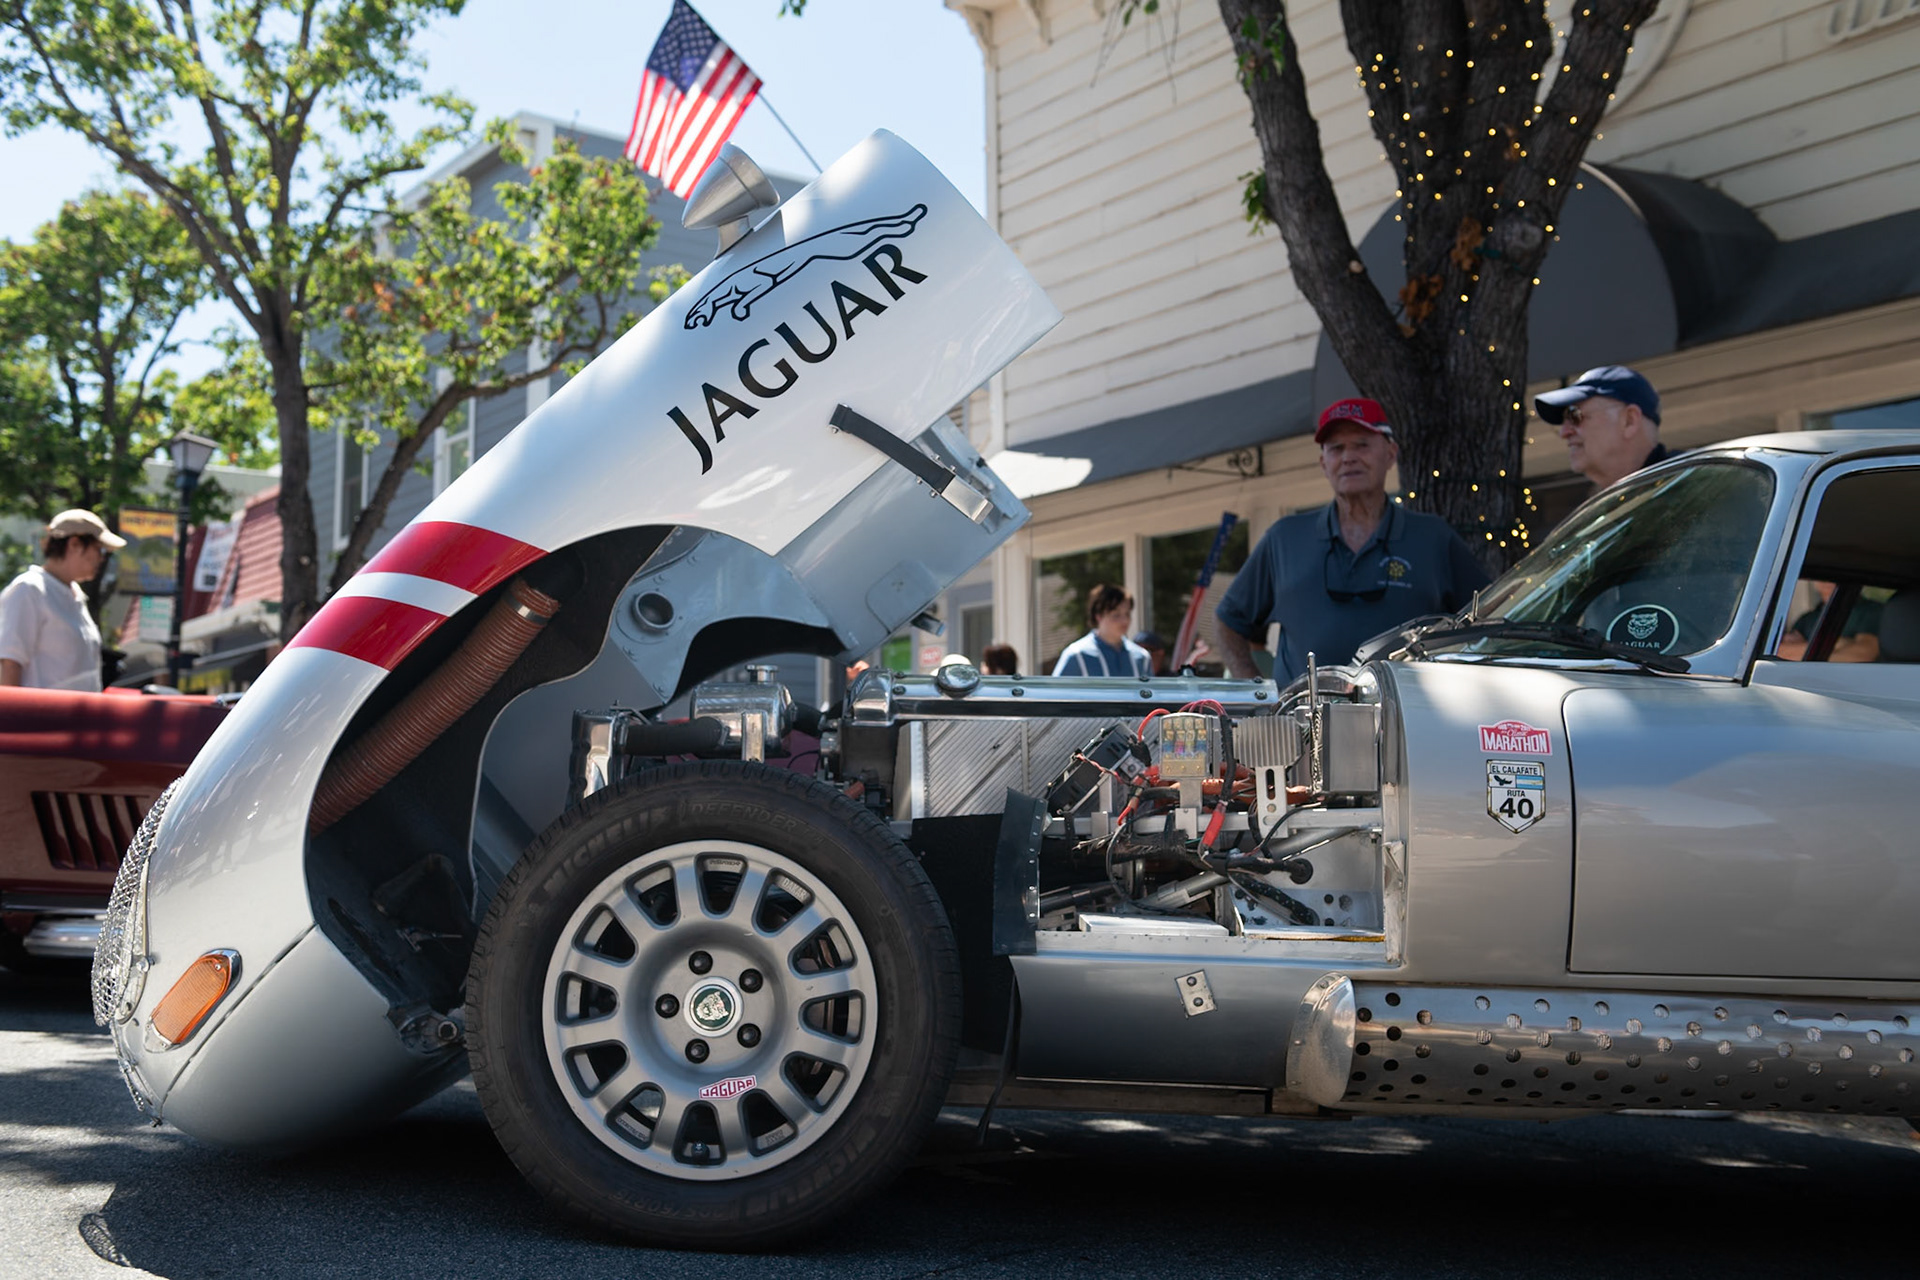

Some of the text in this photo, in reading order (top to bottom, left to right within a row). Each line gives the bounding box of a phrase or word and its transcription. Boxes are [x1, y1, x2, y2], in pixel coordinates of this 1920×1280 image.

[666, 243, 928, 475] JAGUAR
[1483, 729, 1547, 753] MARATHON
[1491, 765, 1538, 776] EL CALAFATE
[690, 801, 800, 835] DEFENDER
[1499, 797, 1534, 819] 40
[783, 877, 808, 900] DAKAR
[702, 1079, 753, 1097] JAGUAR
